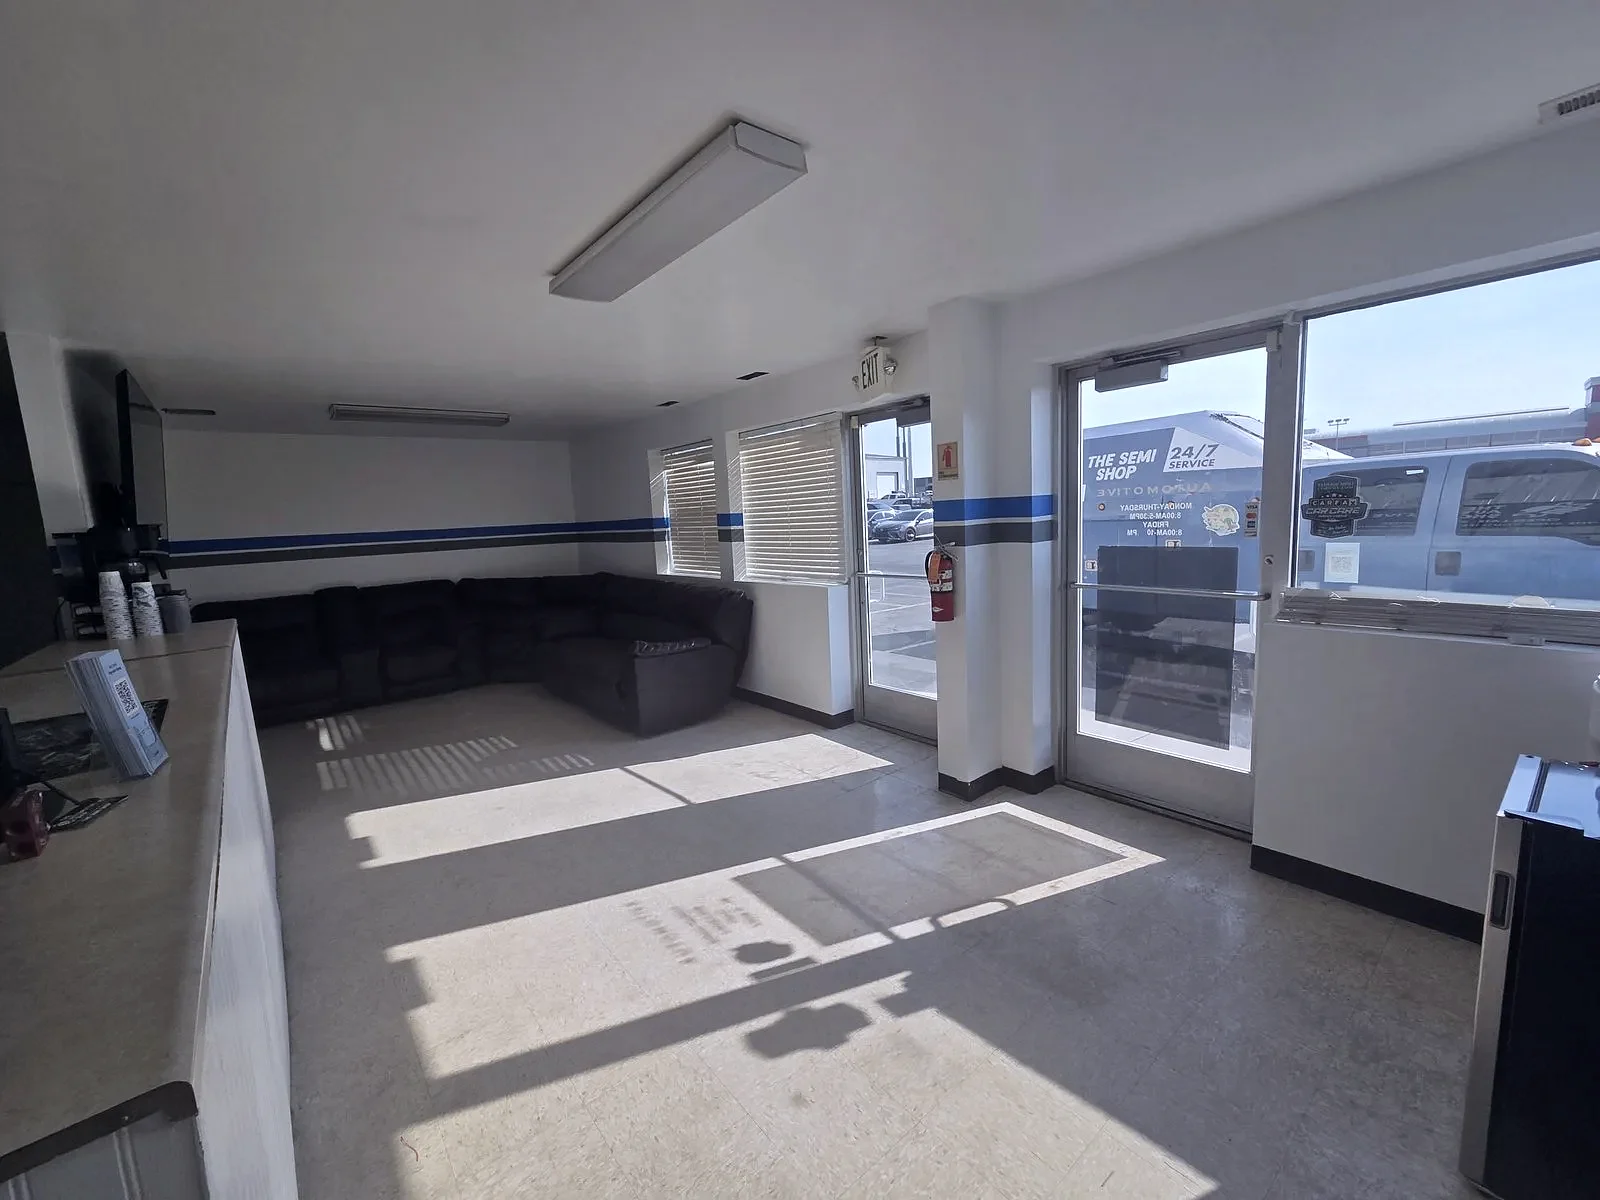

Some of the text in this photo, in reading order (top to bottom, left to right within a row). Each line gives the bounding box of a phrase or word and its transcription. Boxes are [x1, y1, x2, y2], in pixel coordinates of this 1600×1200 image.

[861, 353, 879, 389] EXIT
[1088, 449, 1158, 469] THE SEMI
[1170, 444, 1220, 460] 24/7
[1168, 459, 1216, 469] SERVICE
[1096, 465, 1137, 481] SHOP
